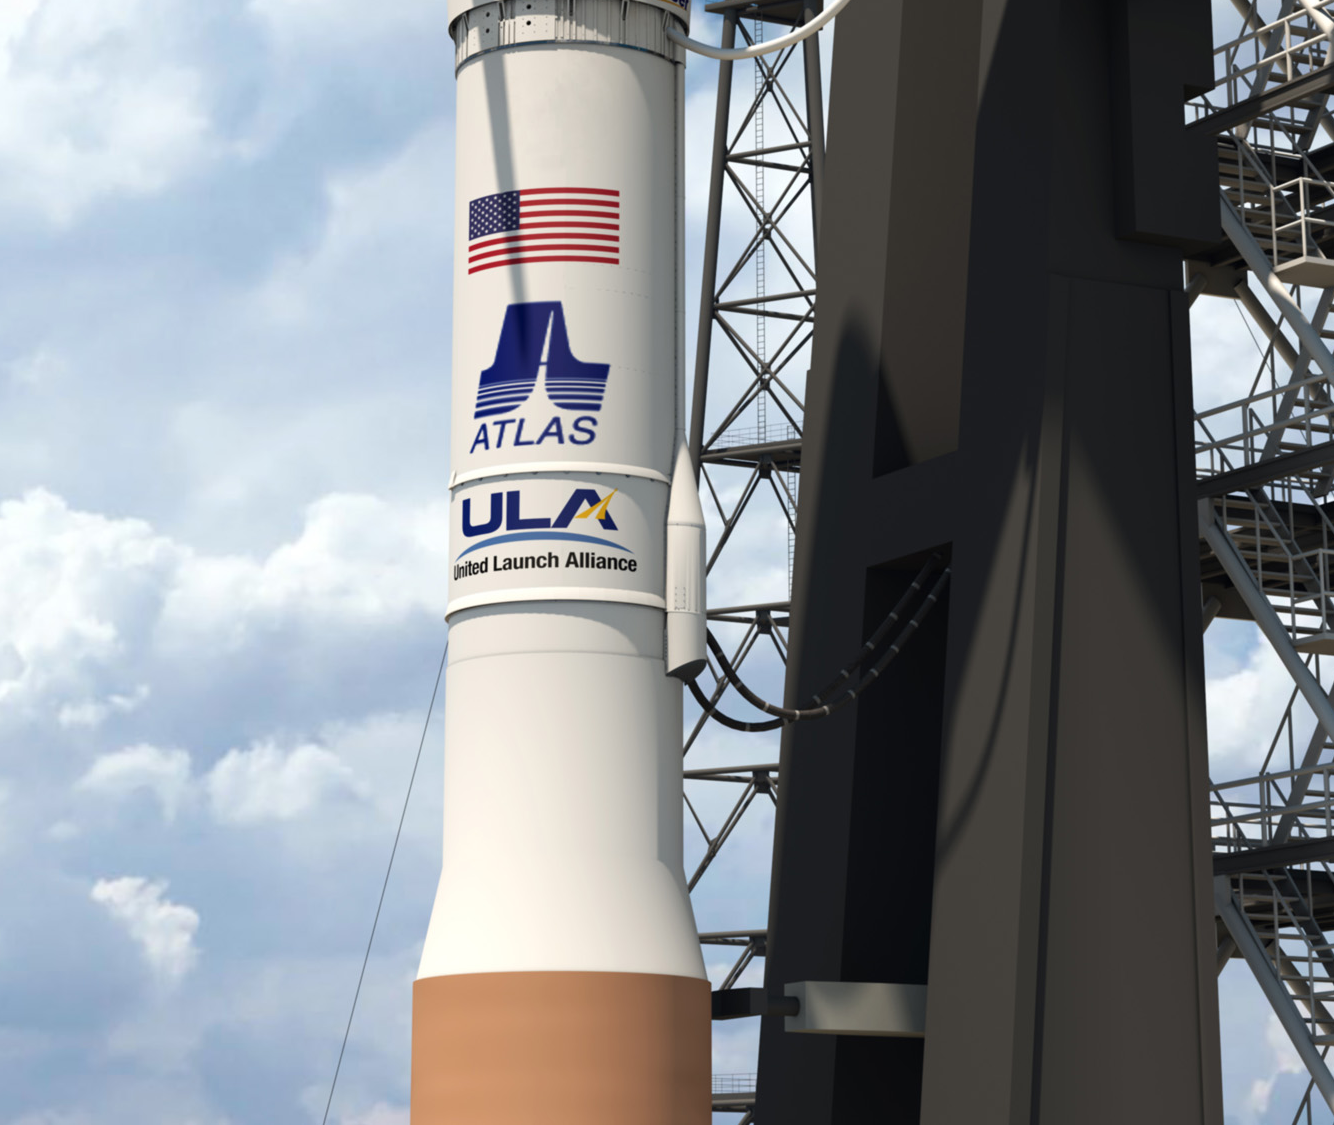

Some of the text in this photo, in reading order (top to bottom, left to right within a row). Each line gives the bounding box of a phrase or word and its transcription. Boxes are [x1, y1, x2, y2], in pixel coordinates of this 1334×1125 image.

[469, 416, 598, 454] ATLAS
[462, 488, 619, 537] ULA
[453, 551, 638, 581] United Launch Alliance
